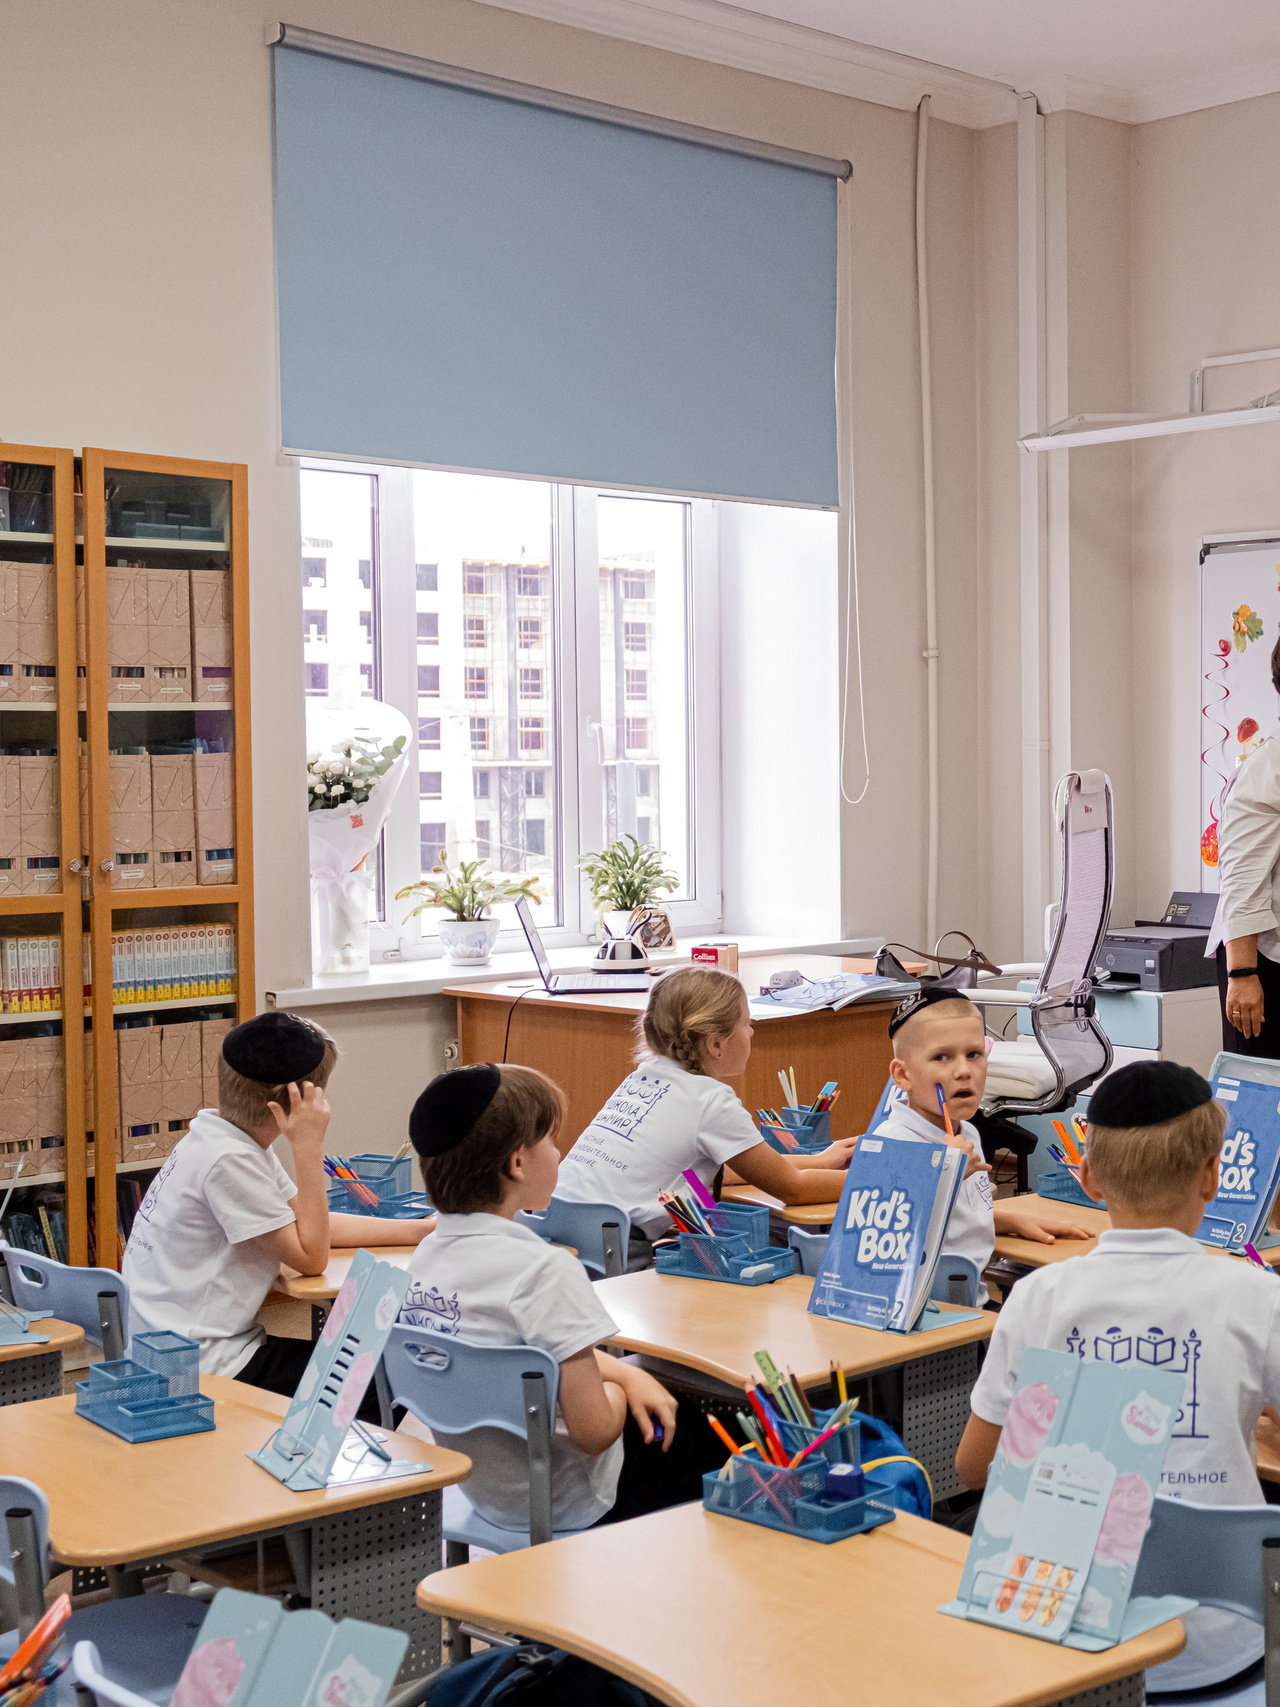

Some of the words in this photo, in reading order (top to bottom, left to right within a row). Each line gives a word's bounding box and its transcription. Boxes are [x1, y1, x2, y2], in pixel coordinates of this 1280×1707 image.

[1220, 1131, 1256, 1166] d's
[1218, 1163, 1256, 1192] ox
[845, 1189, 912, 1231] Kid's
[1229, 1192, 1256, 1200] Generation
[1232, 1222, 1247, 1243] 2
